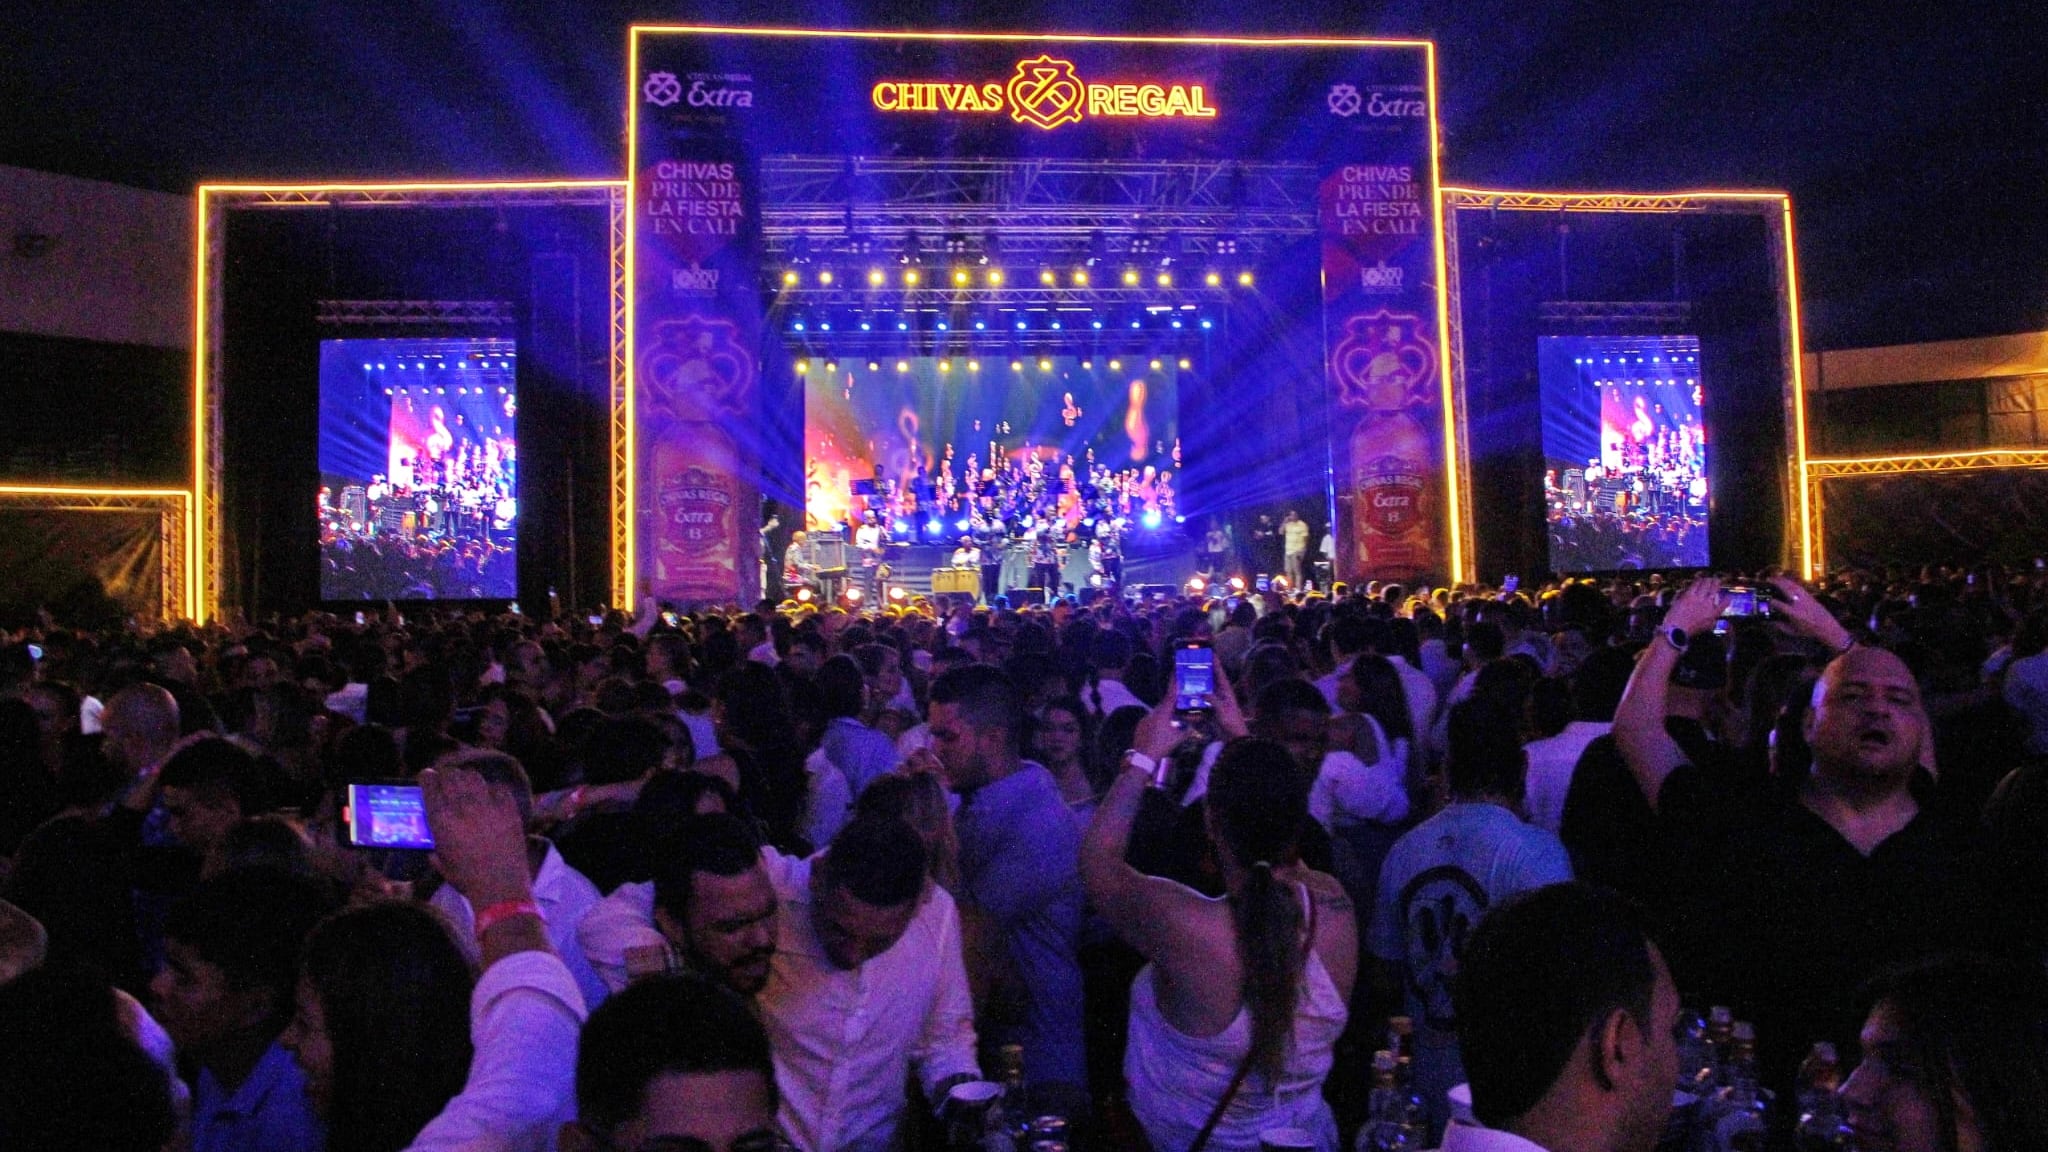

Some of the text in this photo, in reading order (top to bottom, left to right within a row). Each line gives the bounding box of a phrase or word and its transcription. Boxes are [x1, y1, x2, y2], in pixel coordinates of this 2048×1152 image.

[687, 81, 752, 107] Extra
[872, 83, 1216, 117] CHIVAS REGAL
[1367, 92, 1425, 117] Extra
[657, 163, 734, 180] CHIVAS
[1343, 166, 1411, 183] CHIVAS
[652, 182, 741, 198] PRENDE
[1338, 184, 1419, 200] PRENDE
[648, 200, 743, 217] LA FIESTA
[1336, 202, 1422, 218] LA FIESTA
[654, 217, 736, 235] EN CALI
[1343, 219, 1418, 235] EN CALI
